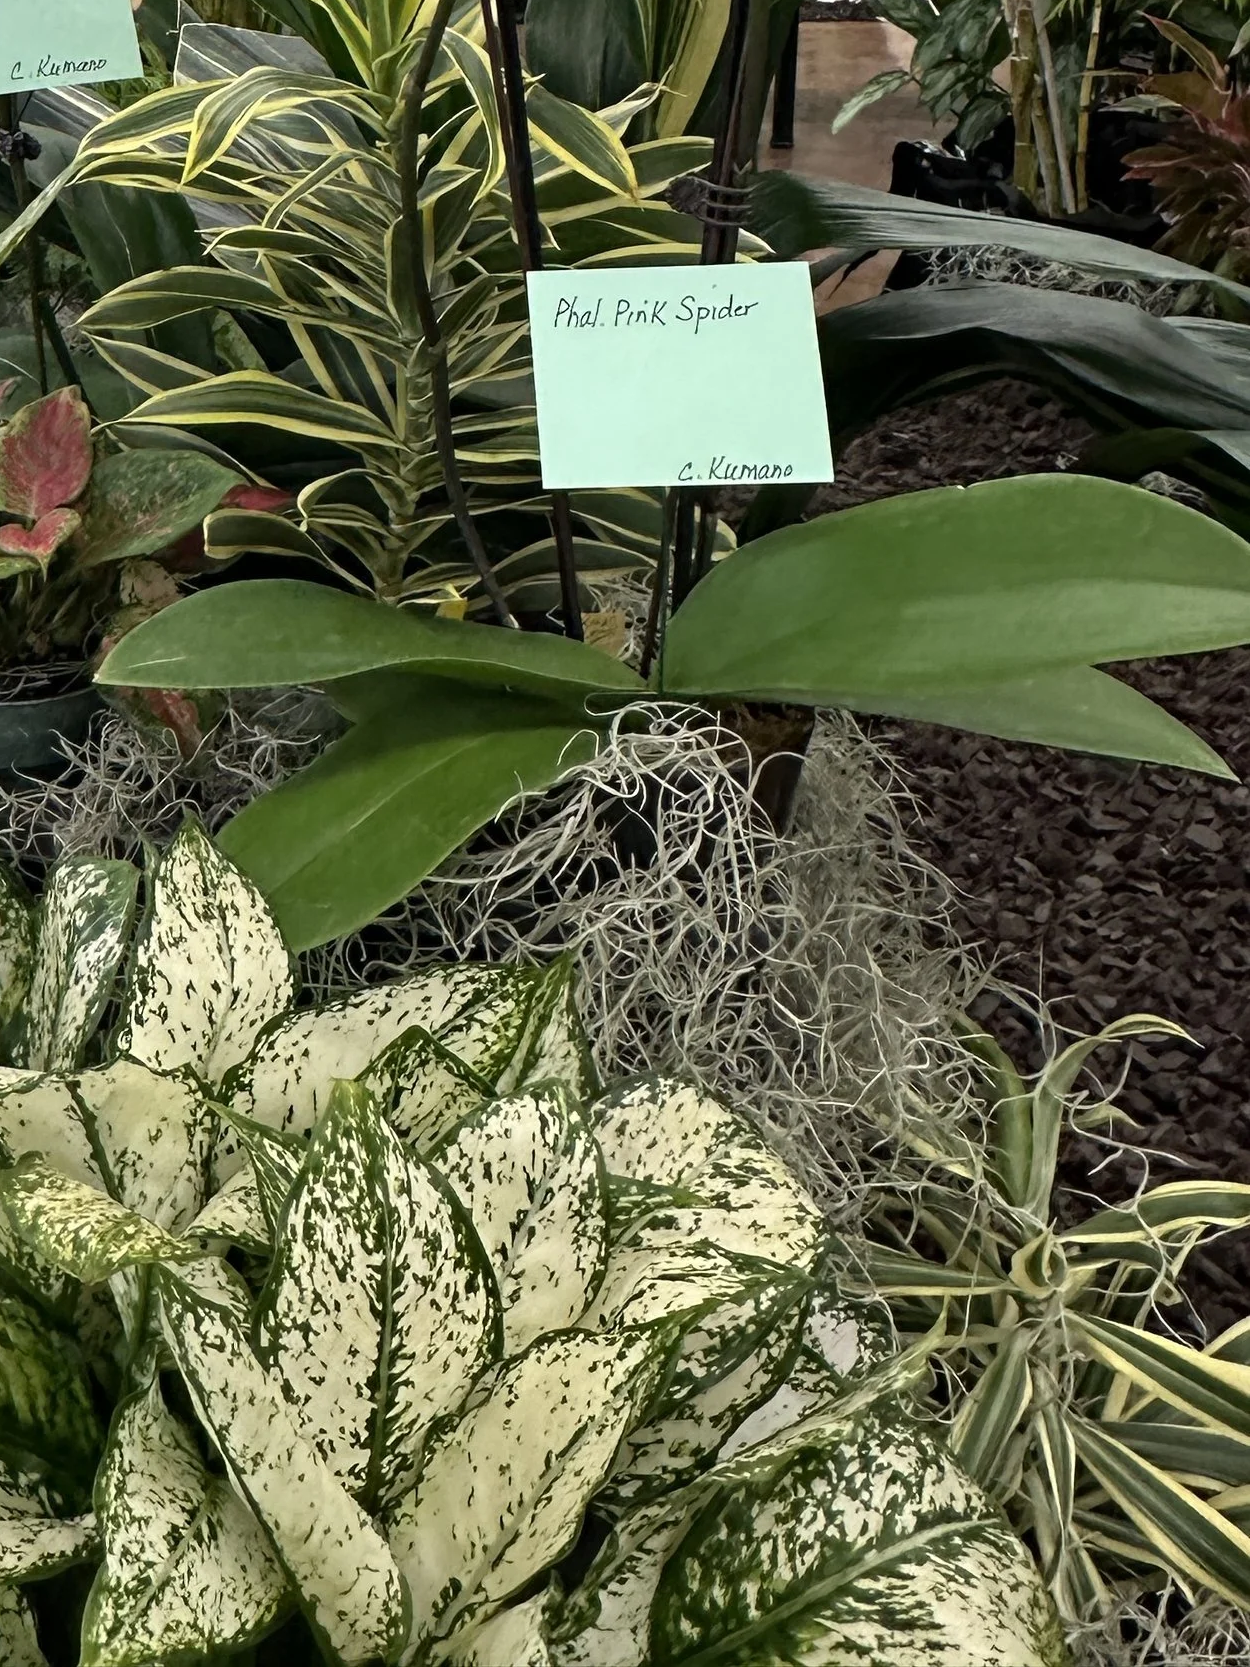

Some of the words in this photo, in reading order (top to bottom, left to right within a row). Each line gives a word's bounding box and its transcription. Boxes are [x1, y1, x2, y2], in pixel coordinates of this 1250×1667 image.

[10, 60, 33, 81] C.
[36, 54, 108, 79] Kumano
[553, 295, 605, 329] Phal.
[614, 298, 667, 327] Pink
[675, 292, 760, 335] Spider
[677, 461, 702, 482] C.
[707, 455, 794, 481] Kumano
